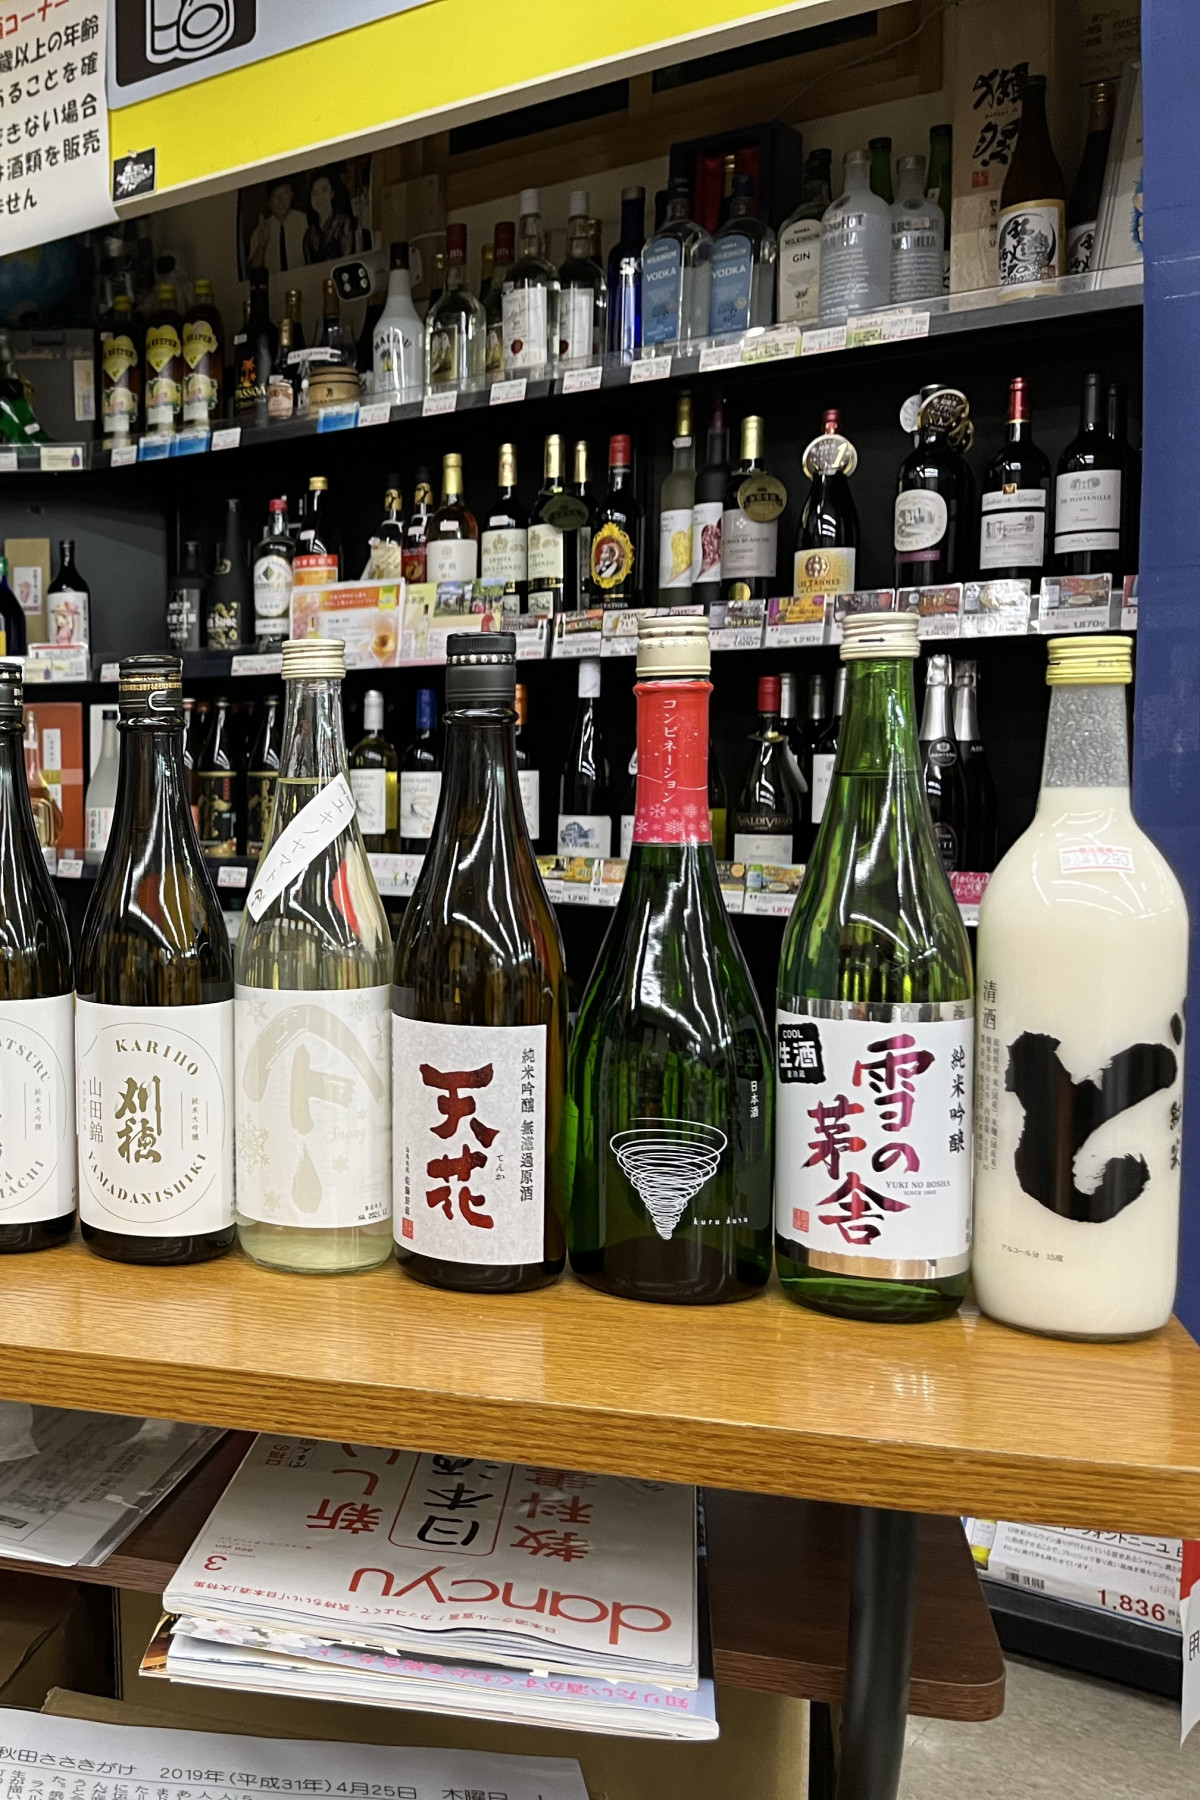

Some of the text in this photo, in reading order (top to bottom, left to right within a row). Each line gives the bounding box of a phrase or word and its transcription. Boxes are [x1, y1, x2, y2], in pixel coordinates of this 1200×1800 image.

[646, 267, 678, 283] VODKA
[712, 263, 748, 280] VODKA
[792, 252, 812, 264] GIN
[662, 699, 680, 803] コンビネーション
[982, 979, 998, 1032] 清酒
[115, 1038, 200, 1077] KARIHO
[778, 1040, 819, 1069] 生酒
[782, 1028, 804, 1039] COOL
[89, 1076, 104, 1144] 山田錦
[114, 1075, 163, 1164] 刈穂
[520, 1048, 536, 1202] 純米吟醸 無濾過原酒
[749, 1080, 760, 1119] 日本酒
[852, 1033, 936, 1174] 雪の
[948, 1045, 966, 1154] 純米吟醸
[419, 1063, 500, 1229] 天花
[494, 1154, 506, 1182] てんか
[800, 1093, 912, 1246] 茅舎
[88, 1150, 207, 1205] YAMADANISHIKI
[885, 1180, 909, 1190] YUKI
[911, 1181, 924, 1189] NO
[203, 1554, 228, 1571] 3
[348, 1565, 673, 1646] dancyu
